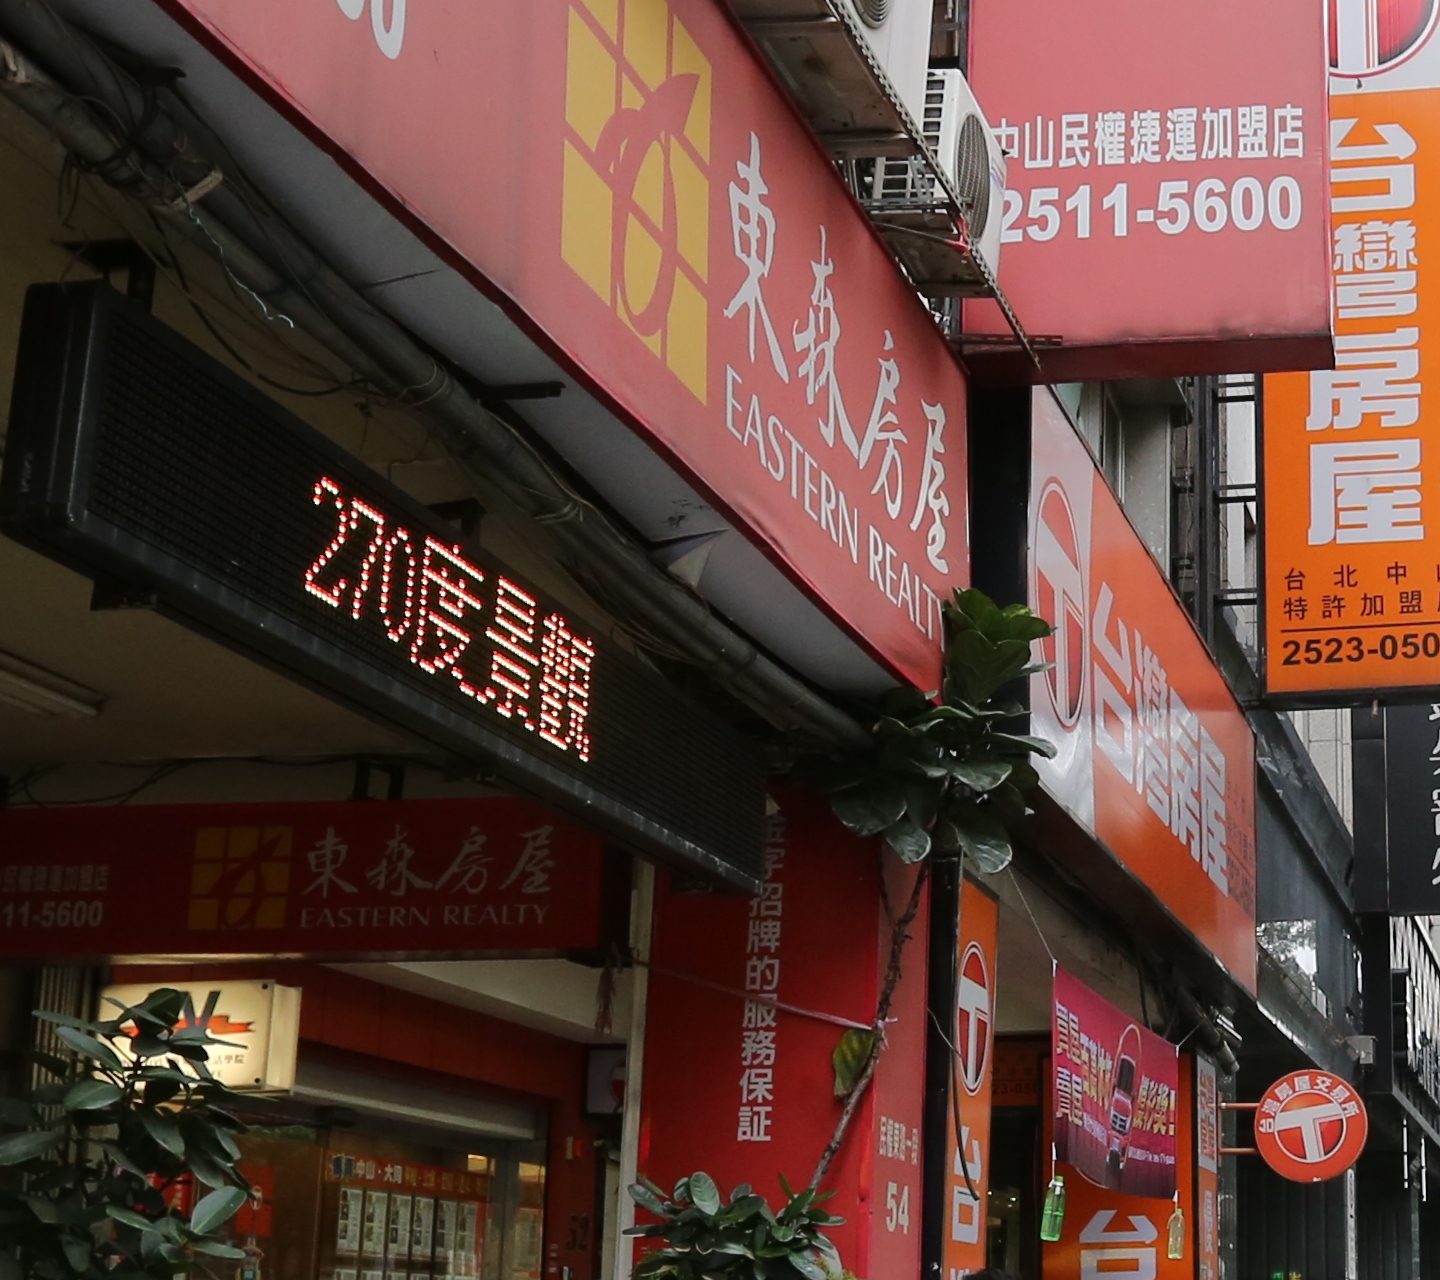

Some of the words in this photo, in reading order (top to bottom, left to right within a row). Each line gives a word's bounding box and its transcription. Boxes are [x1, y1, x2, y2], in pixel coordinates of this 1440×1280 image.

[994, 103, 1304, 170] 中山民權捷運加盟店
[1003, 176, 1302, 243] 2511-5600
[724, 131, 951, 575] 東森房屋
[1306, 117, 1426, 547] 台灣房屋
[724, 364, 858, 564] EASTERN
[1093, 581, 1229, 898] 台灣房屋
[302, 825, 556, 898] 東森房屋
[300, 906, 429, 929] EASTERN
[443, 904, 549, 926] REALTY
[886, 1183, 909, 1234] 54
